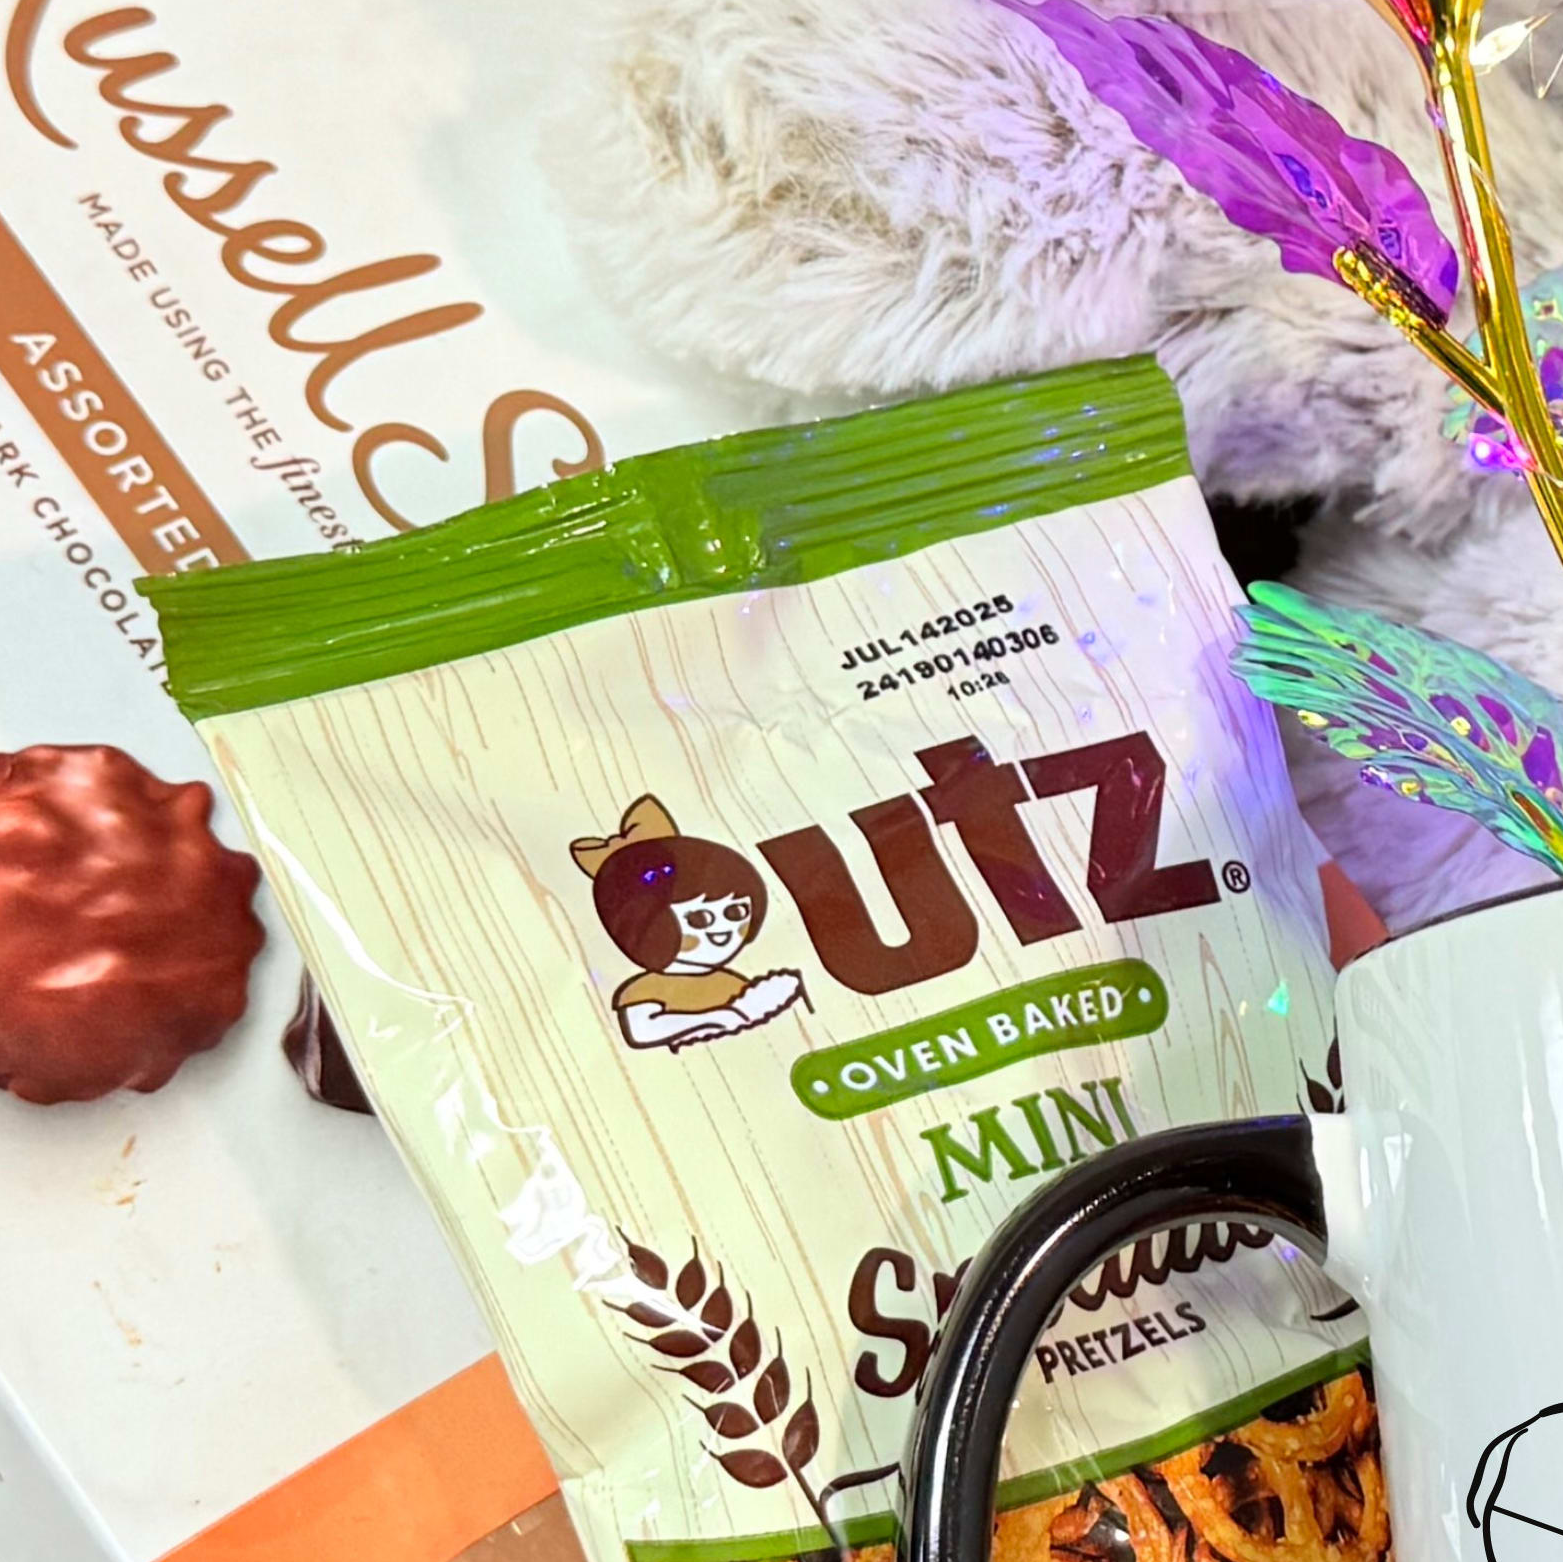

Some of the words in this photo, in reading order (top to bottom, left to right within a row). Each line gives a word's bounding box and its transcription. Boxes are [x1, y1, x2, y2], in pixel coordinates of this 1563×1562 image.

[78, 192, 159, 284] MADE
[148, 287, 230, 383] USING
[225, 385, 283, 451] THE
[840, 593, 1015, 671] JUL142025
[856, 623, 1060, 701] 24190140306
[840, 1027, 979, 1091] OVEN
[985, 985, 1125, 1047] BAKED
[919, 1076, 1139, 1204] MINI
[1036, 1300, 1207, 1385] PRETZELS
